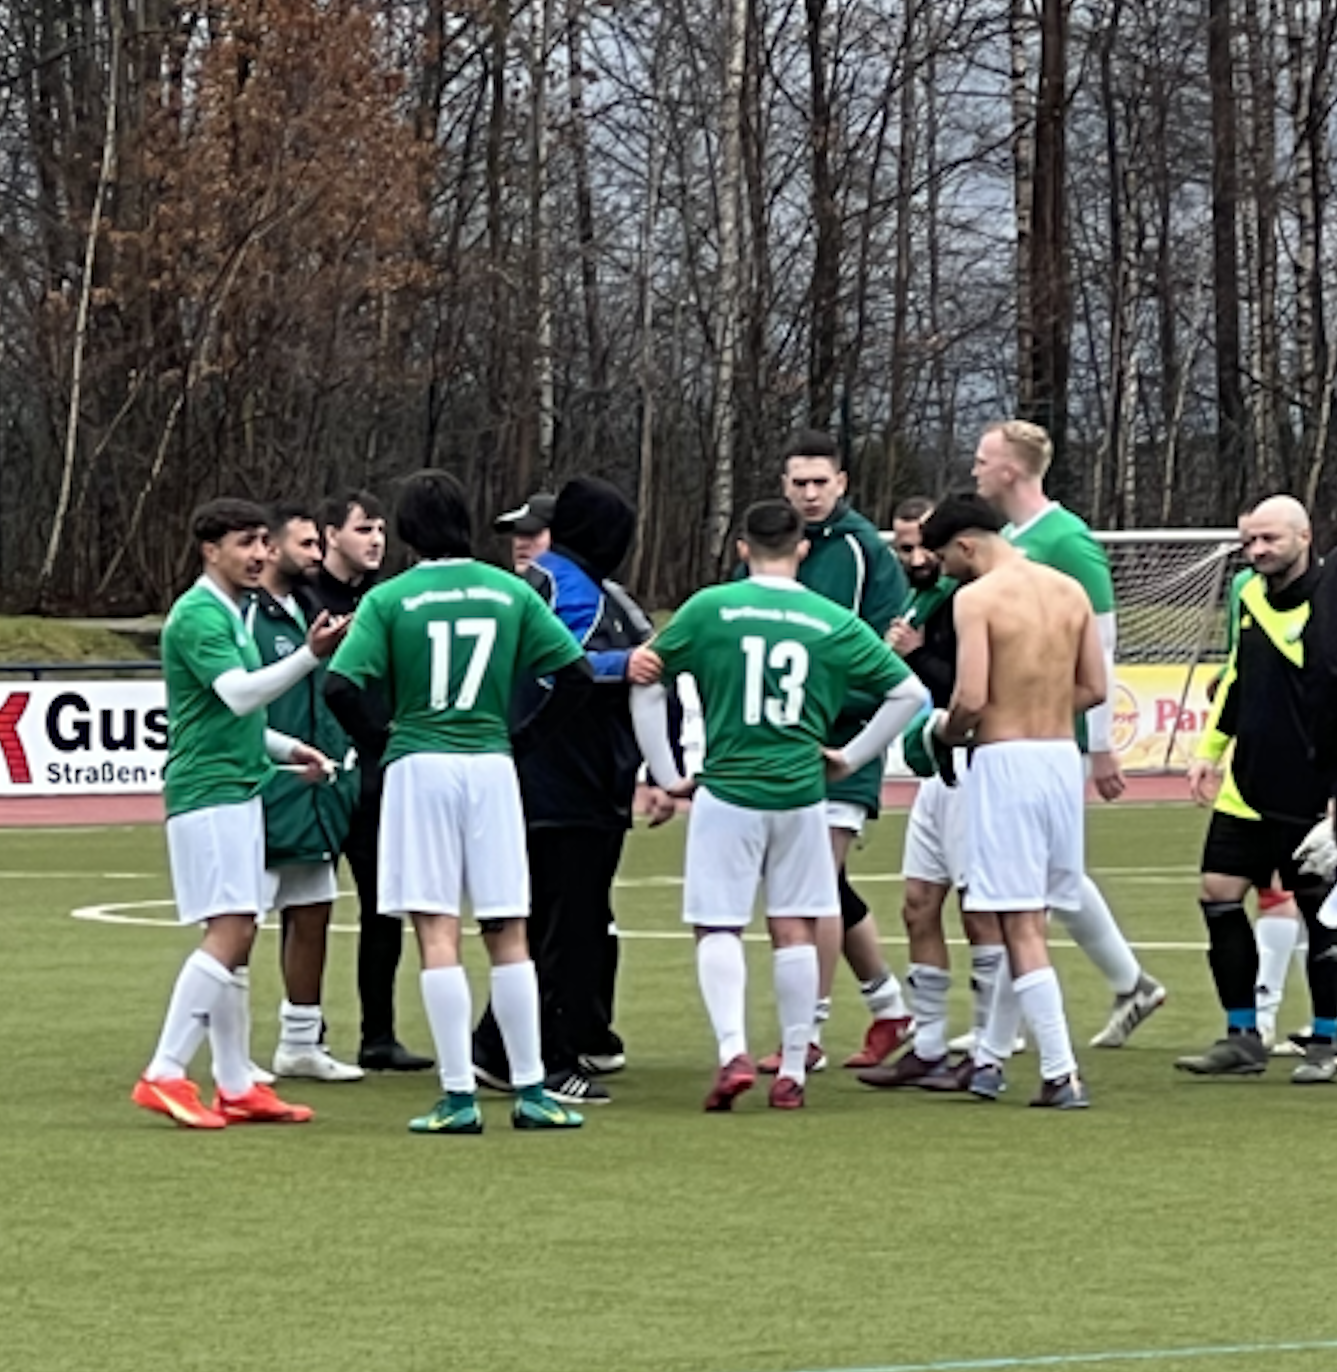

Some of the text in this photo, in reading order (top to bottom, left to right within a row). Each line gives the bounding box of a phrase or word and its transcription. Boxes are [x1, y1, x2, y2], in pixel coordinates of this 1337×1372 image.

[427, 618, 497, 710] 17
[741, 635, 809, 726] 13
[45, 691, 169, 752] Gus
